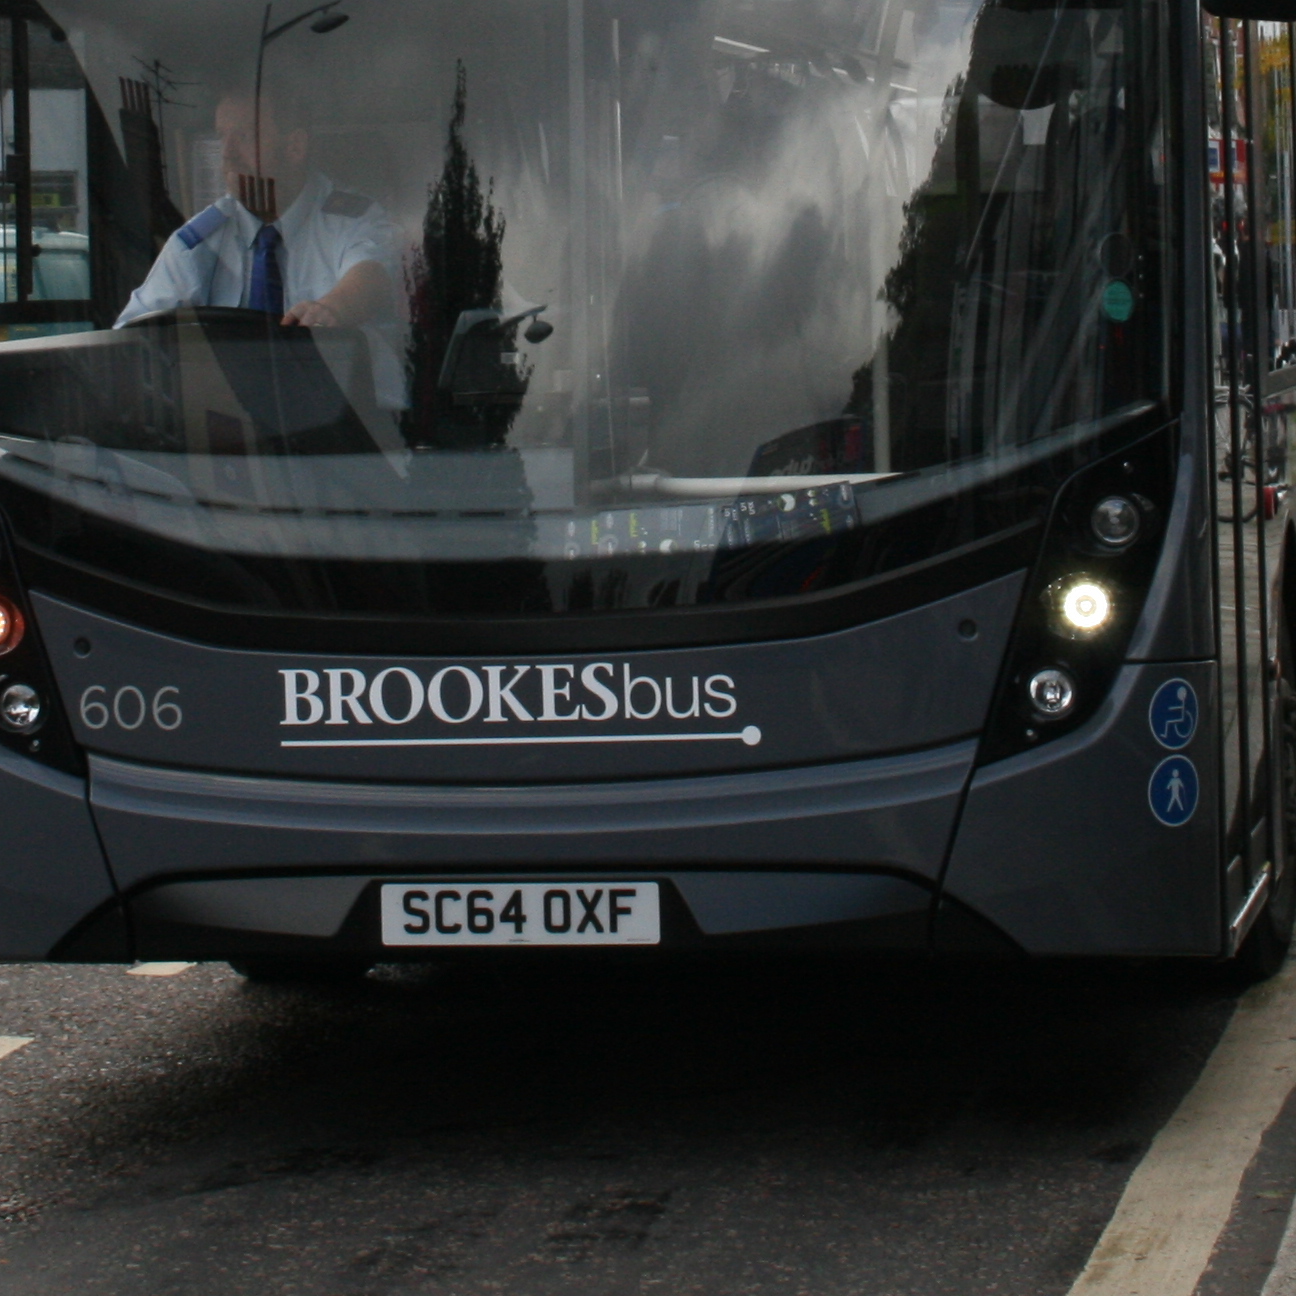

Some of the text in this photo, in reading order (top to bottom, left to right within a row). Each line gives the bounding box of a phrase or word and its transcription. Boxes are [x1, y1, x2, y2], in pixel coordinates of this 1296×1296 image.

[79, 685, 182, 730] 606
[402, 889, 636, 934] SC64 OXF
